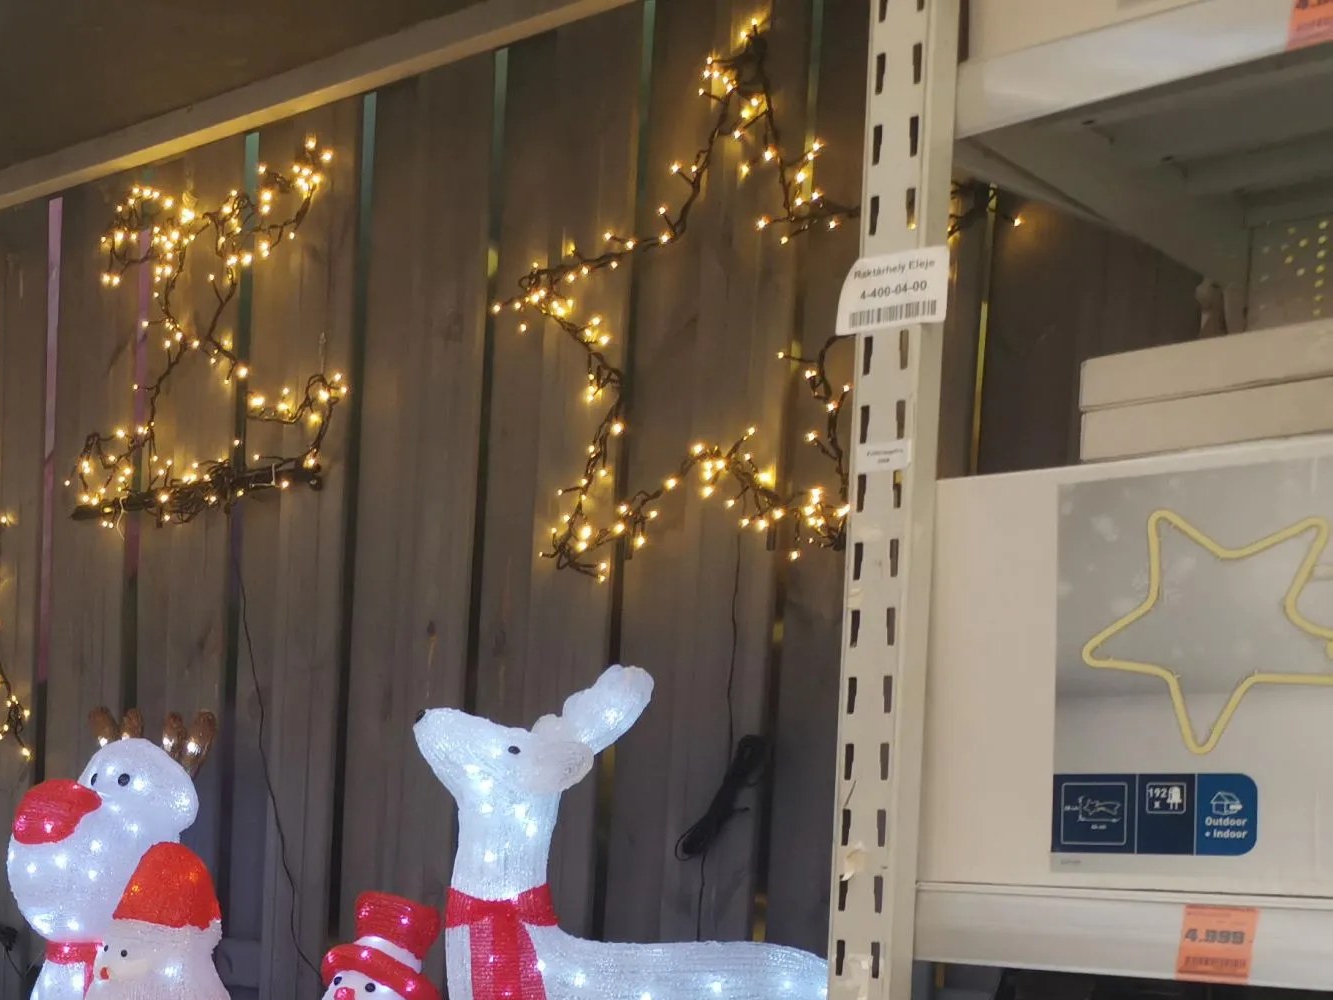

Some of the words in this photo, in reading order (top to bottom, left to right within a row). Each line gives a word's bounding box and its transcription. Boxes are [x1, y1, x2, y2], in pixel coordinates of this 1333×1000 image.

[860, 280, 927, 299] 4-400-04-00
[1148, 787, 1168, 799] 192
[1205, 816, 1248, 827] Outdoor
[1213, 829, 1248, 839] Indoor
